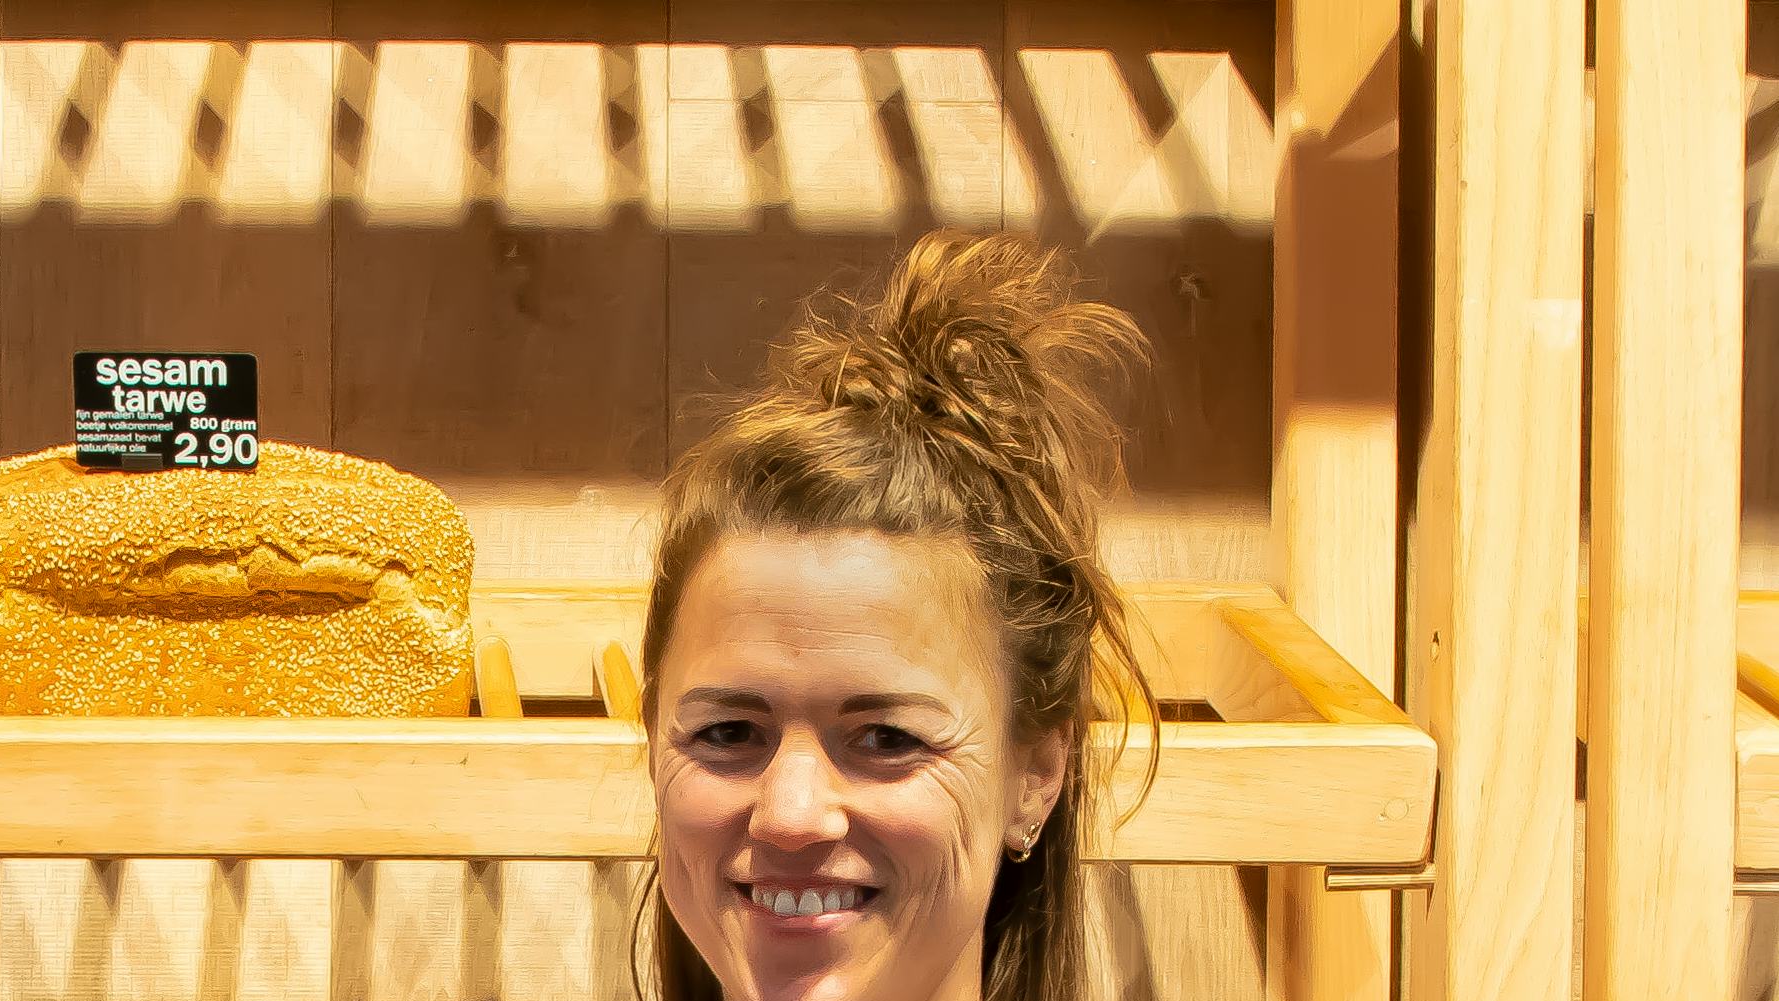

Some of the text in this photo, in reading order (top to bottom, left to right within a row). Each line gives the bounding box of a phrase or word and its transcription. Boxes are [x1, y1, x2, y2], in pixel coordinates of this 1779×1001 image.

[96, 358, 228, 386] sesam
[112, 385, 207, 414] tarwe
[108, 422, 173, 431] volkorenmeel
[190, 417, 257, 433] 800 gram
[77, 433, 132, 442] sesamzaad
[77, 443, 127, 454] natuurlijke
[174, 432, 258, 468] 2,90
